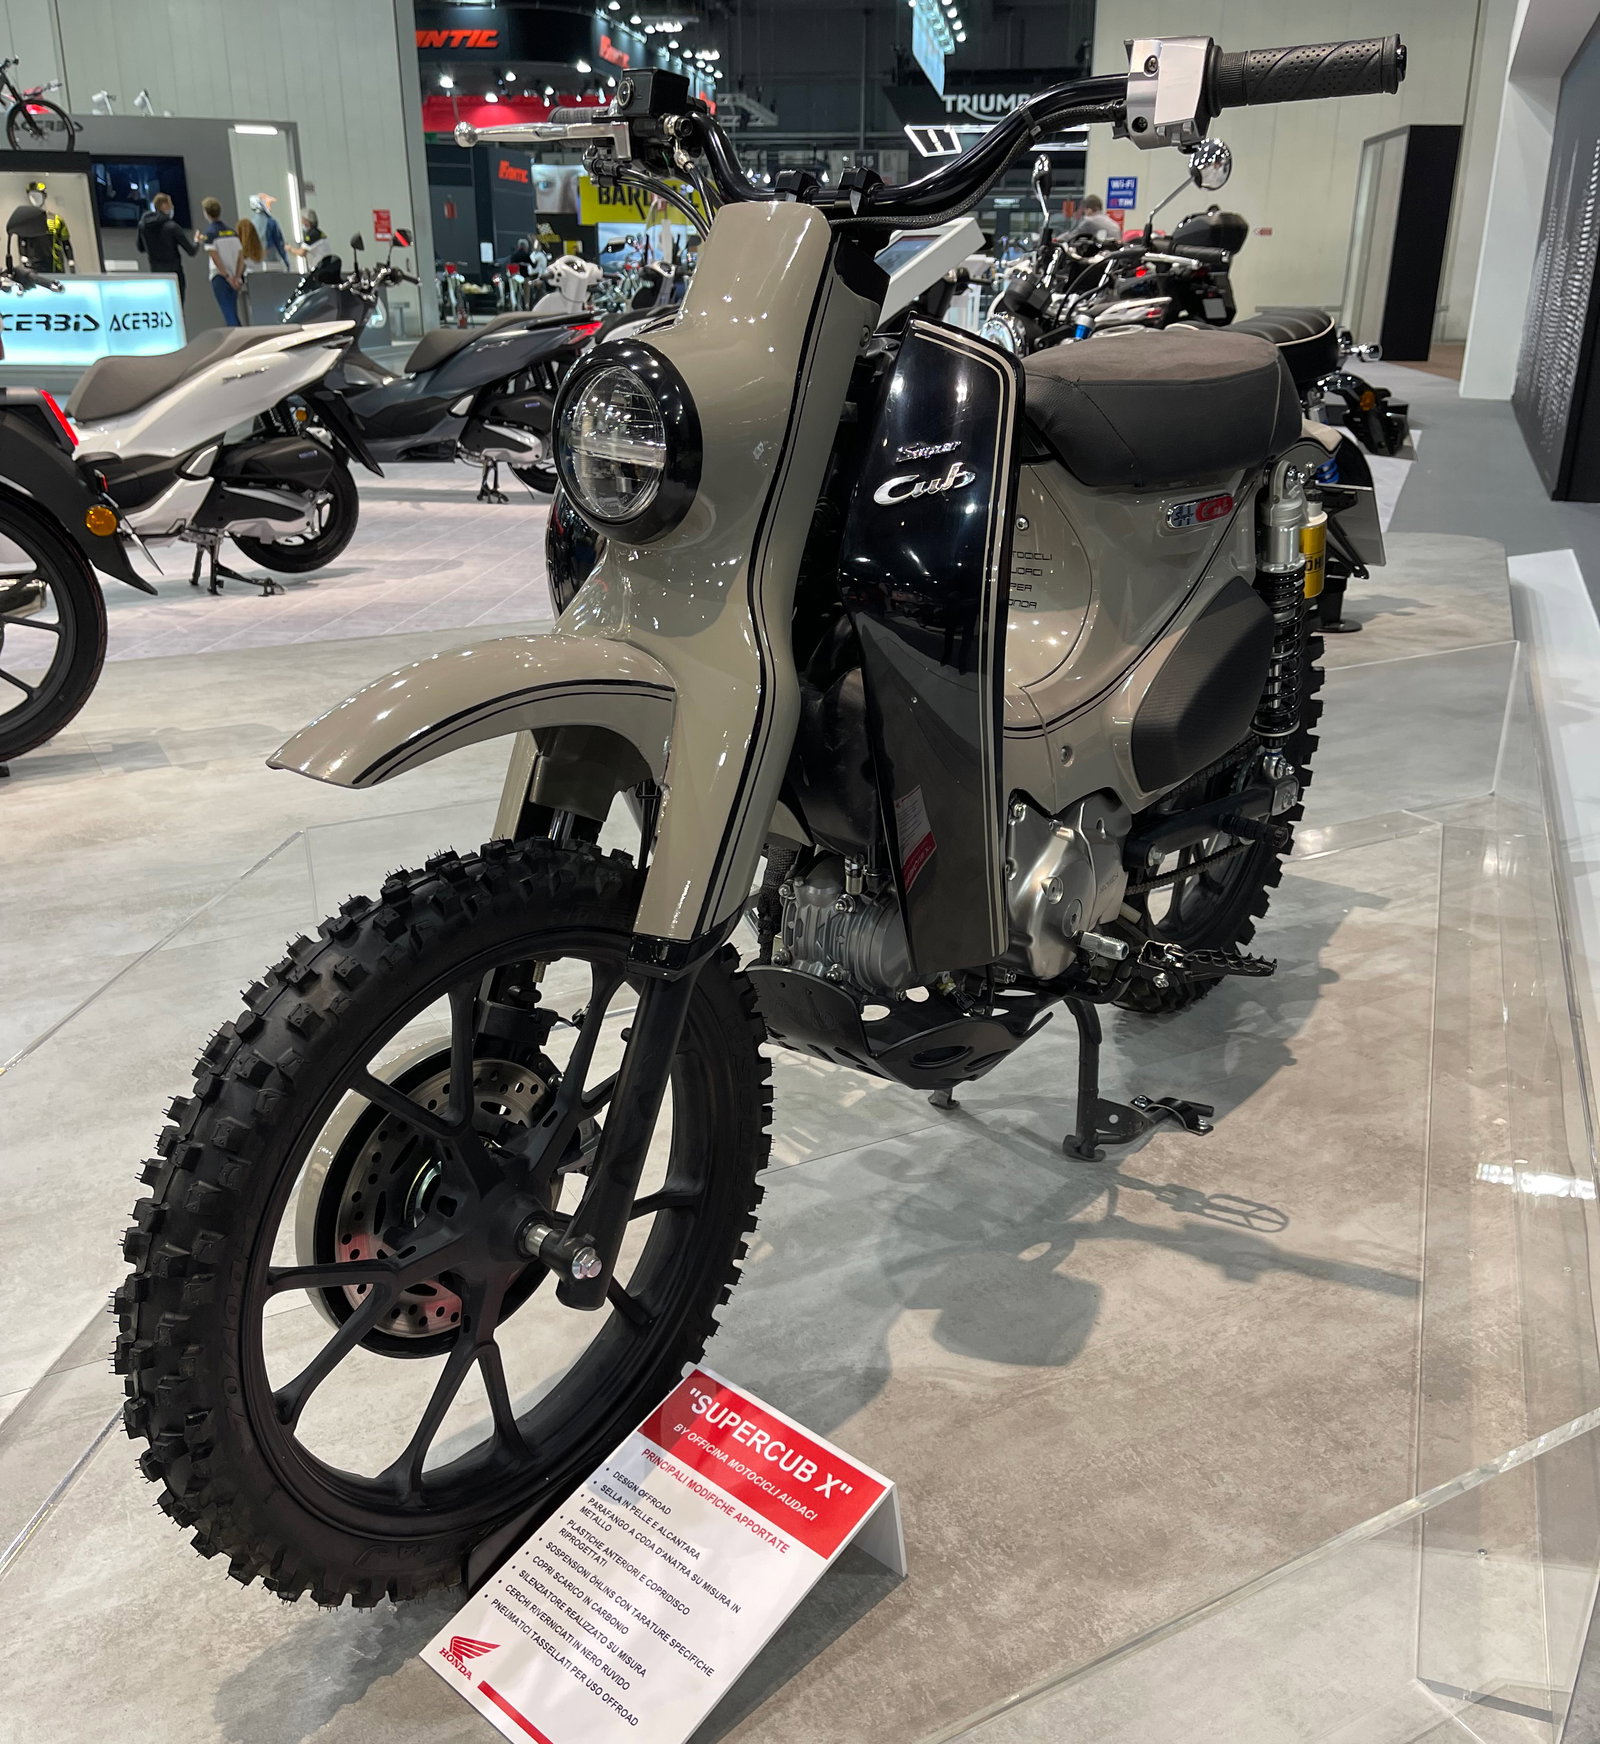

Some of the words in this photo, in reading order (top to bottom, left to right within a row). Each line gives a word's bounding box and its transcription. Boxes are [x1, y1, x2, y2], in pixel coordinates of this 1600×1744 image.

[2, 314, 100, 331] CERBIS
[873, 461, 977, 507] Cub
[673, 1423, 690, 1434] BY
[687, 1432, 728, 1462] OFFICINA
[727, 1458, 780, 1496] MOTOCICLI
[776, 1493, 818, 1521] AUDACI
[689, 1387, 817, 1482] "SUPERCUB
[813, 1472, 853, 1498] X"
[579, 1505, 611, 1531] METALLO
[600, 1484, 622, 1503] SELLA
[621, 1499, 631, 1509] IN
[628, 1505, 653, 1524] PELLE
[650, 1520, 659, 1529] E
[656, 1526, 700, 1560] ALCANTARA
[612, 1471, 639, 1492] DESIGN
[637, 1489, 671, 1514] OFFROAD
[641, 1448, 689, 1483] PRINCIPALI
[686, 1479, 735, 1516] MODIFICHE
[732, 1512, 790, 1553] APPORTATE
[532, 1555, 555, 1575] COPRI
[552, 1571, 584, 1598] SCARICO
[581, 1595, 592, 1605] IN
[590, 1602, 628, 1634] CARBONIO
[558, 1527, 607, 1567] RIPROGETTATI
[566, 1519, 604, 1550] PLASTICHE
[601, 1547, 640, 1577] ANTERIORI
[638, 1573, 647, 1582] E
[645, 1579, 690, 1615] COPRIDISCO
[587, 1497, 629, 1530] PARAFANGO
[634, 1532, 655, 1551] CODA
[654, 1546, 691, 1577] D'ANATRA
[690, 1573, 703, 1585] SU
[701, 1581, 731, 1607] MISURA
[730, 1603, 741, 1613] IN
[505, 1584, 532, 1608] CERCHI
[528, 1604, 574, 1643] RIVERNICIATI
[571, 1639, 582, 1650] IN
[579, 1646, 602, 1667] NERO
[600, 1663, 630, 1690] RUVIDO
[518, 1569, 567, 1610] SILENZIATORE
[563, 1606, 608, 1644] REALIZZATO
[606, 1641, 619, 1653] SU
[616, 1650, 646, 1677] MISURA
[545, 1541, 591, 1579] SOSPENSIONI
[588, 1575, 615, 1598] ÖHLINS
[614, 1595, 632, 1611] CON
[631, 1607, 670, 1642] TARATURE
[668, 1638, 714, 1677] SPECIFICHE
[438, 1647, 471, 1680] HONDA
[490, 1598, 532, 1635] PNEUMATICI
[530, 1630, 572, 1669] TASSELLATI
[569, 1665, 587, 1682] PER
[585, 1678, 603, 1695] USO
[601, 1692, 638, 1726] OFFROAD
